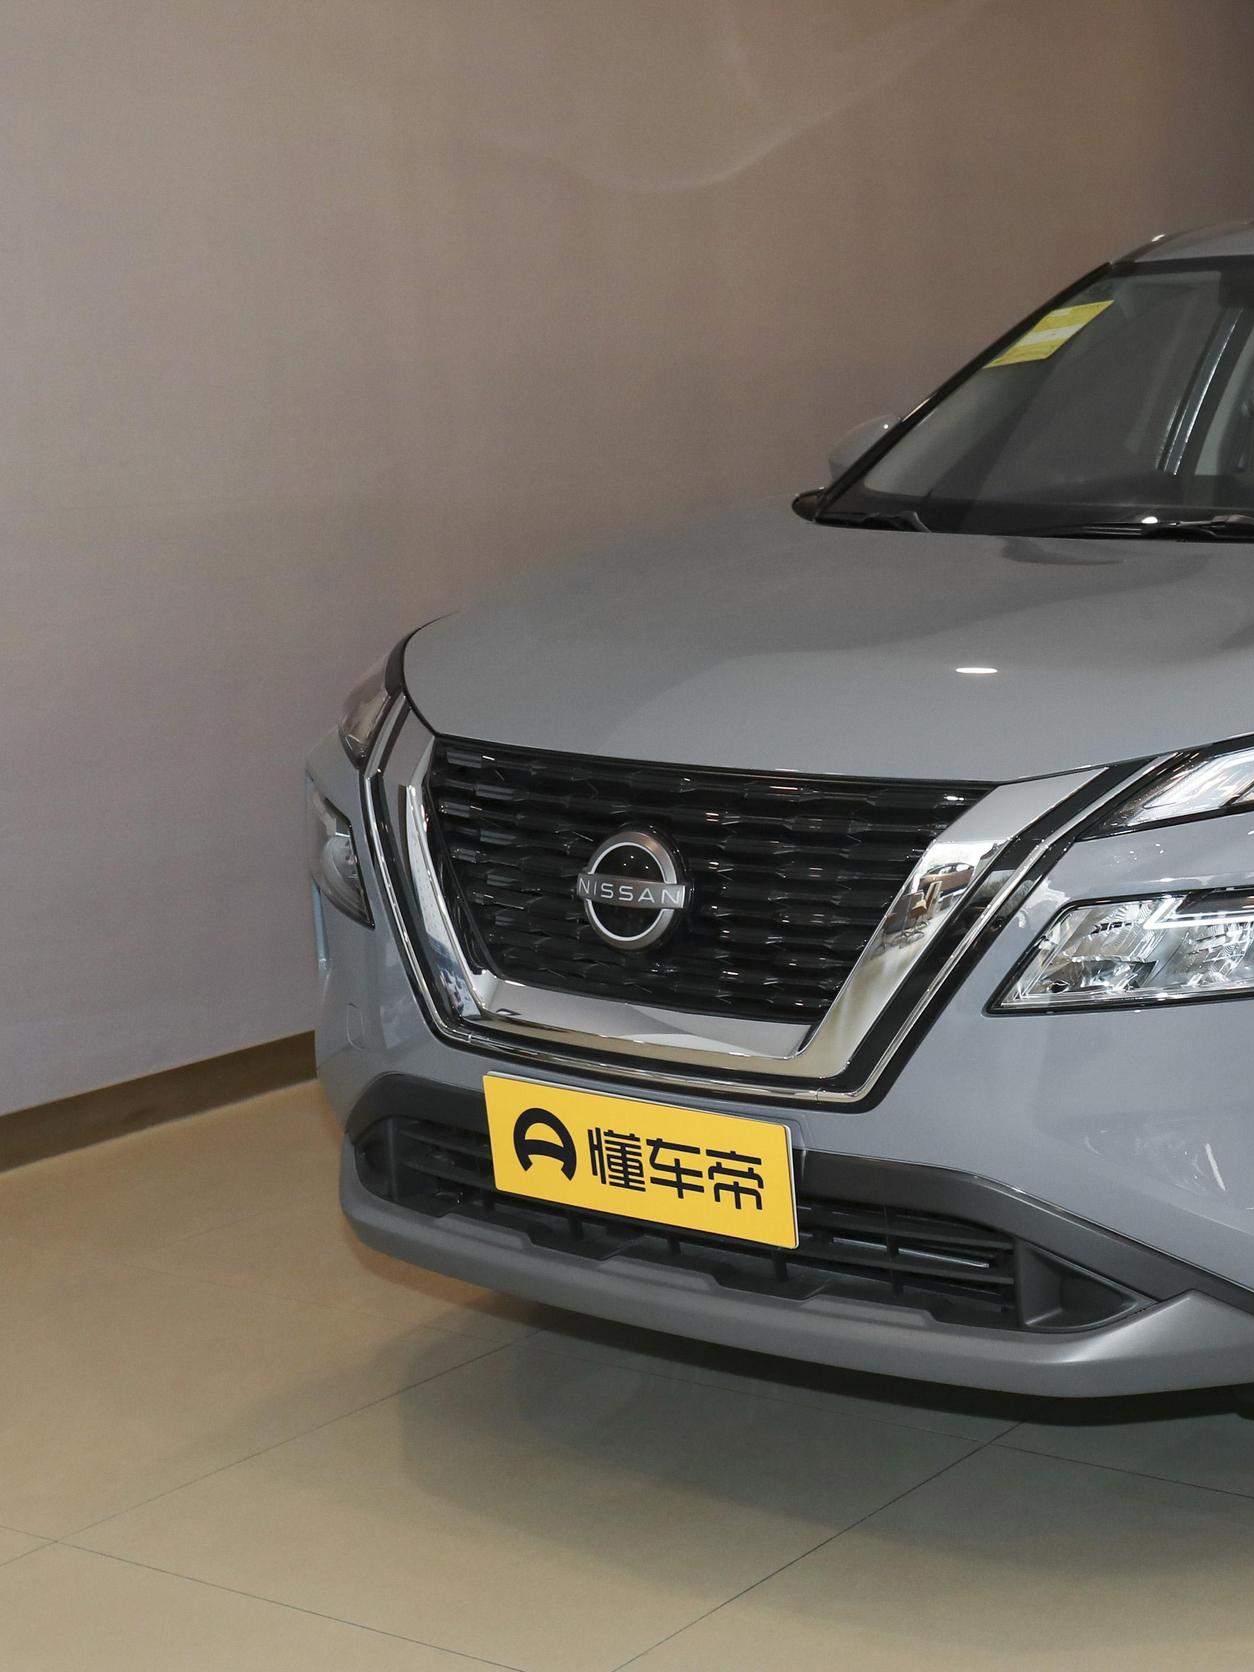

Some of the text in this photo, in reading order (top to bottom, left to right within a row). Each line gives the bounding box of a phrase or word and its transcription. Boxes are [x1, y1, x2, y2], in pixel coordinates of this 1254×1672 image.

[579, 878, 680, 904] NISSAN
[588, 1128, 764, 1210] 懂车帝
